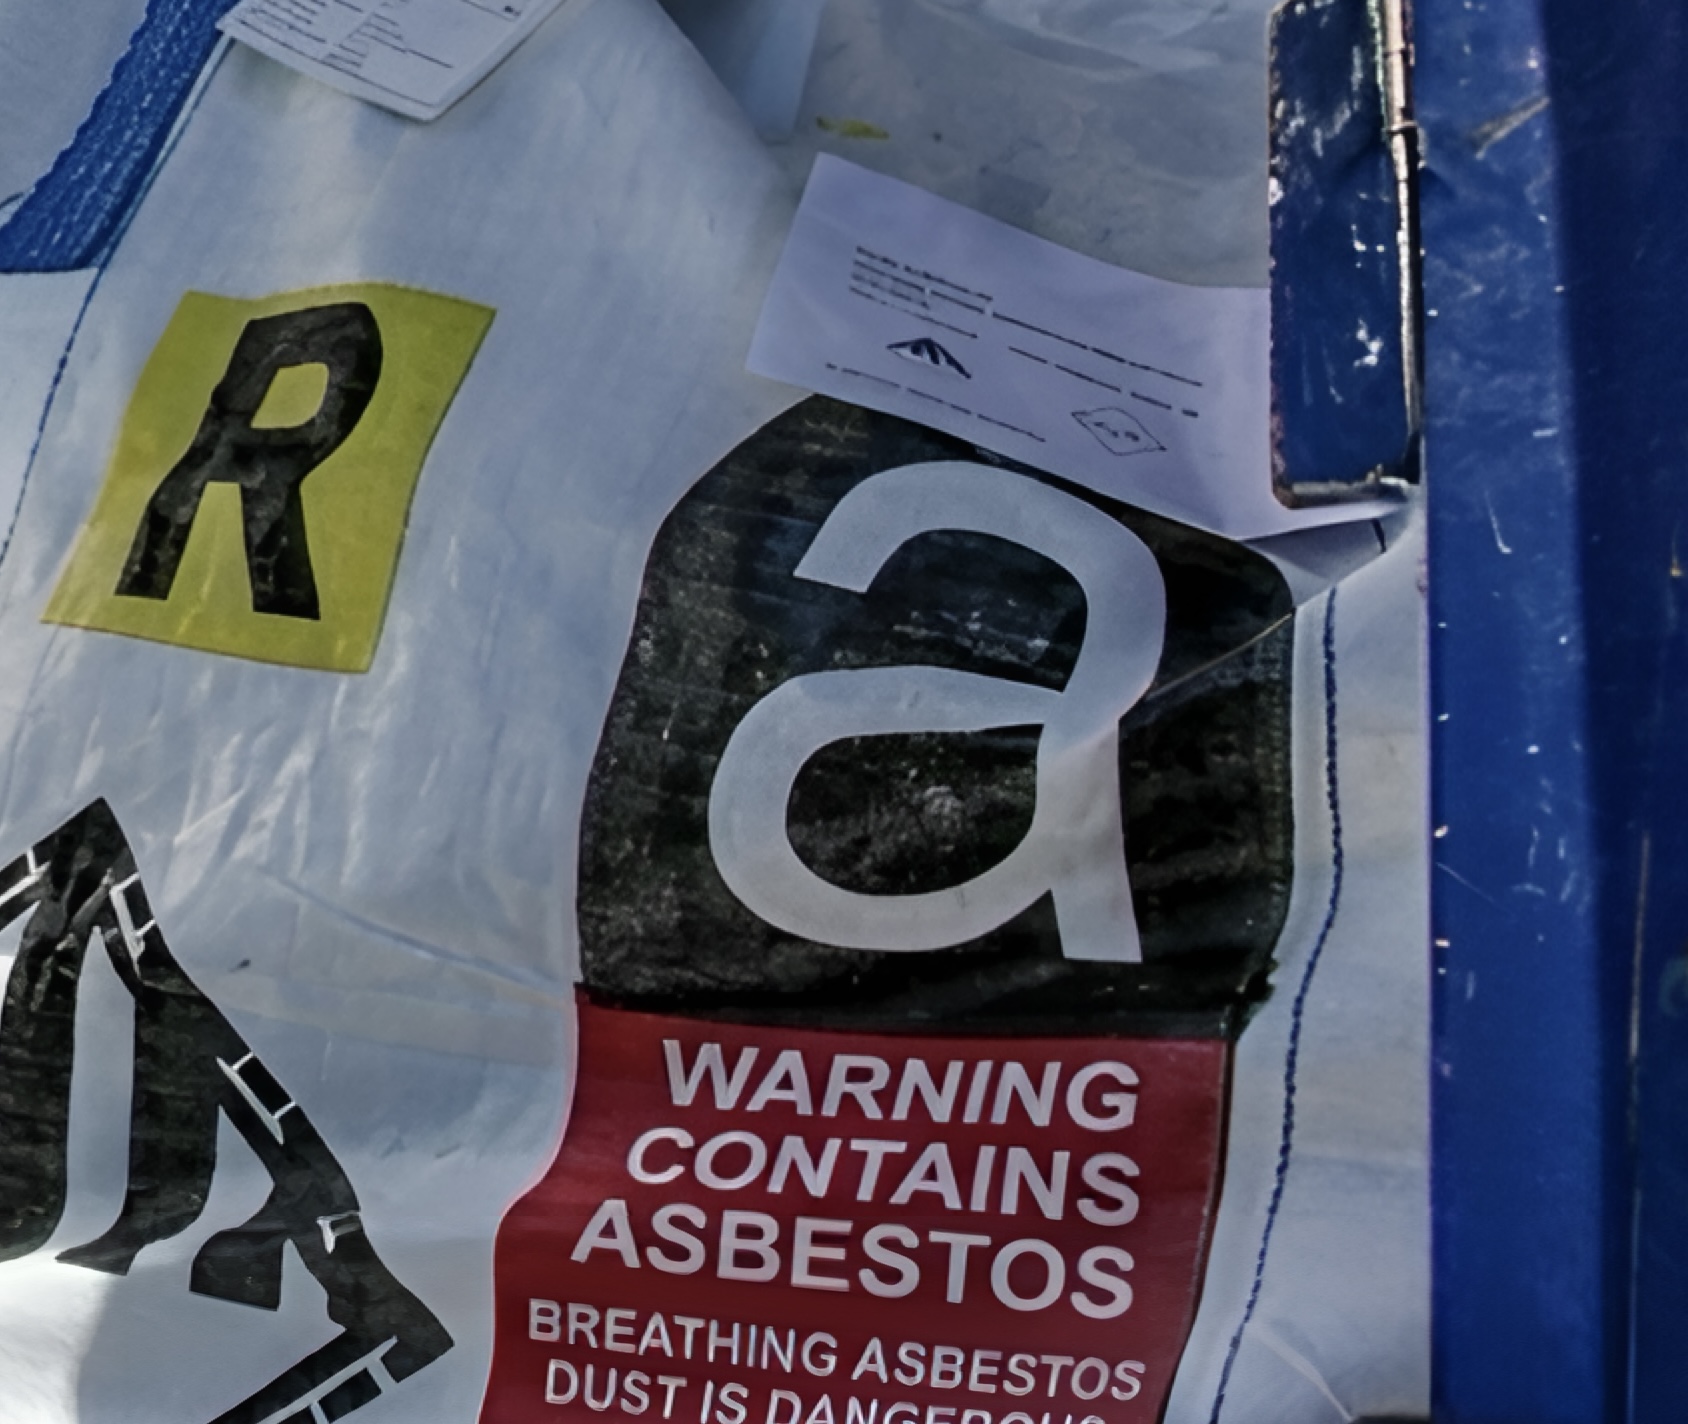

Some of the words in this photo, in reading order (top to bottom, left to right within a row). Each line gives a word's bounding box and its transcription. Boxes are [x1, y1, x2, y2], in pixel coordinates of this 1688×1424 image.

[114, 301, 383, 621] R
[709, 460, 1167, 963] a
[662, 1039, 1140, 1131] WARNING
[626, 1127, 1140, 1226] CONTAINS
[570, 1198, 1135, 1320] ASBESTOS
[529, 1298, 838, 1377] BREATHING
[851, 1337, 1146, 1401] ASBESTOS
[545, 1358, 688, 1420] DUST
[700, 1380, 749, 1424] IS
